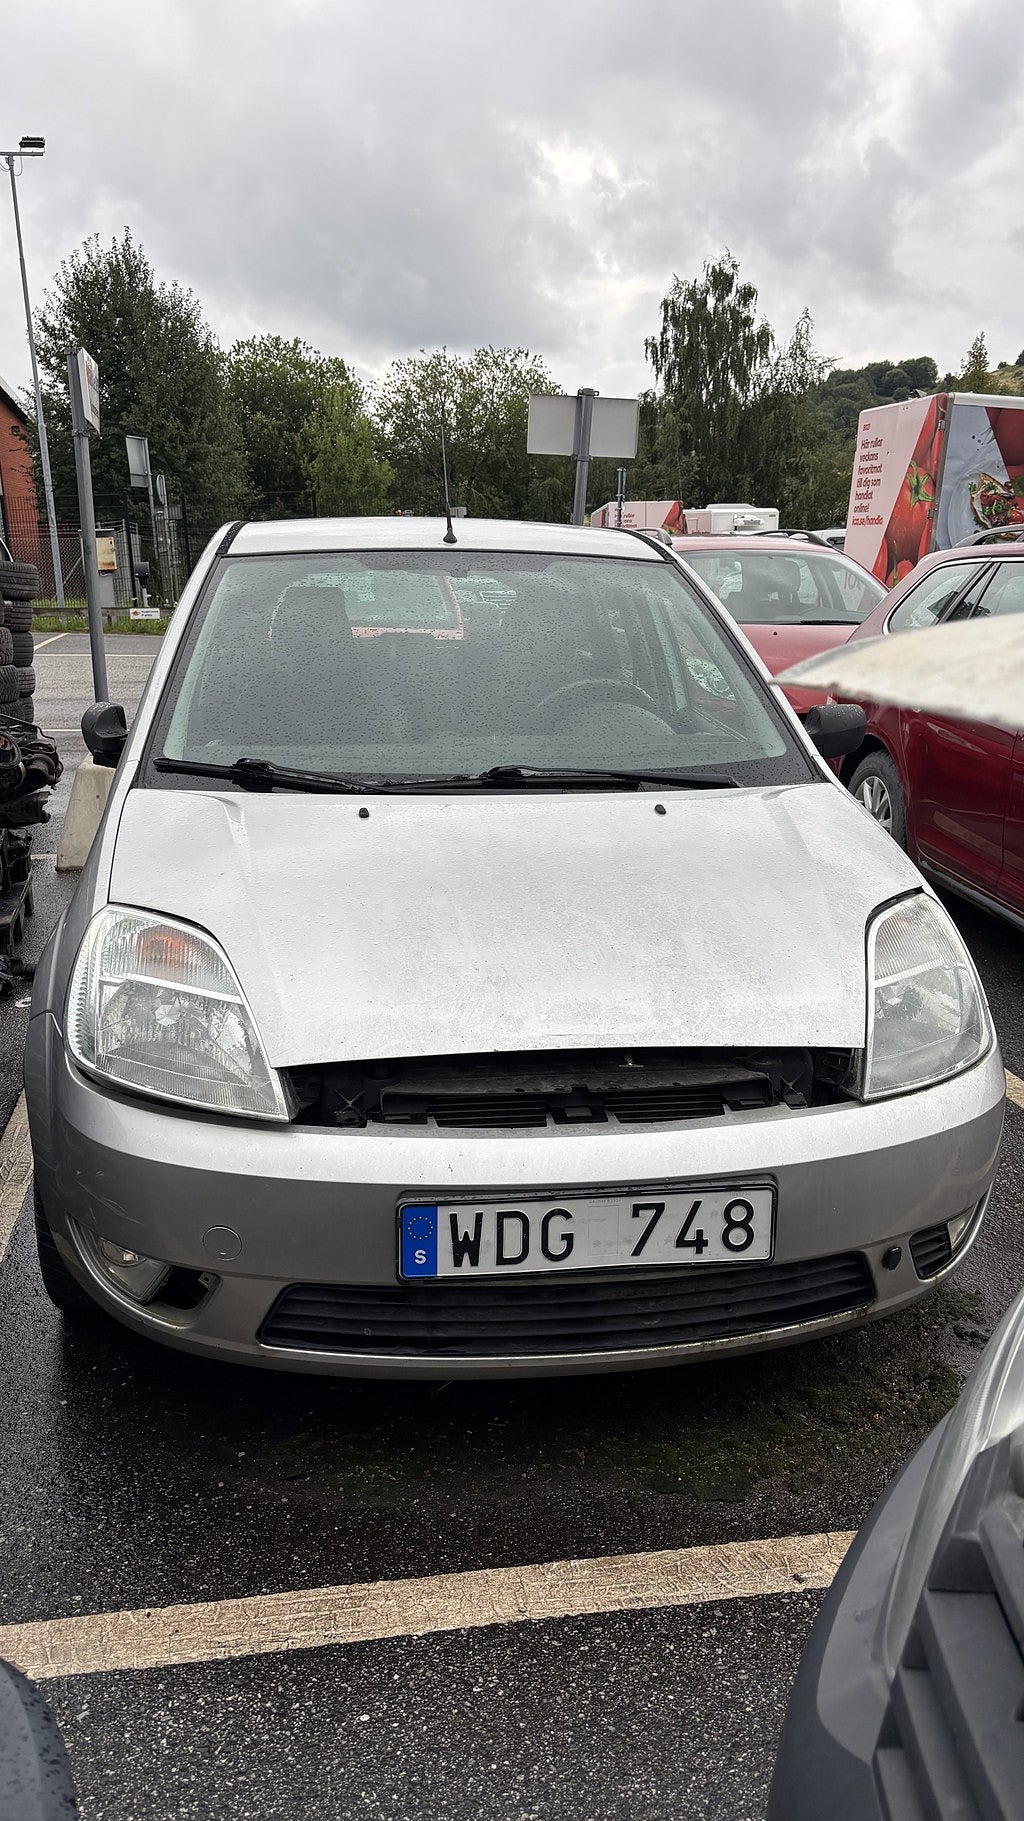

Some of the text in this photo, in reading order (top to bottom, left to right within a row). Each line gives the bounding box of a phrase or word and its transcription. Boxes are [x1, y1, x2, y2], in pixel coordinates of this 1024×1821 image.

[860, 437, 883, 450] Här rullar
[859, 451, 879, 462] veckans
[858, 464, 883, 476] favoritmat
[870, 478, 881, 487] som
[855, 490, 873, 500] handlat
[853, 503, 870, 513] online!
[449, 1197, 755, 1267] WDG 748
[414, 1249, 427, 1265] S
